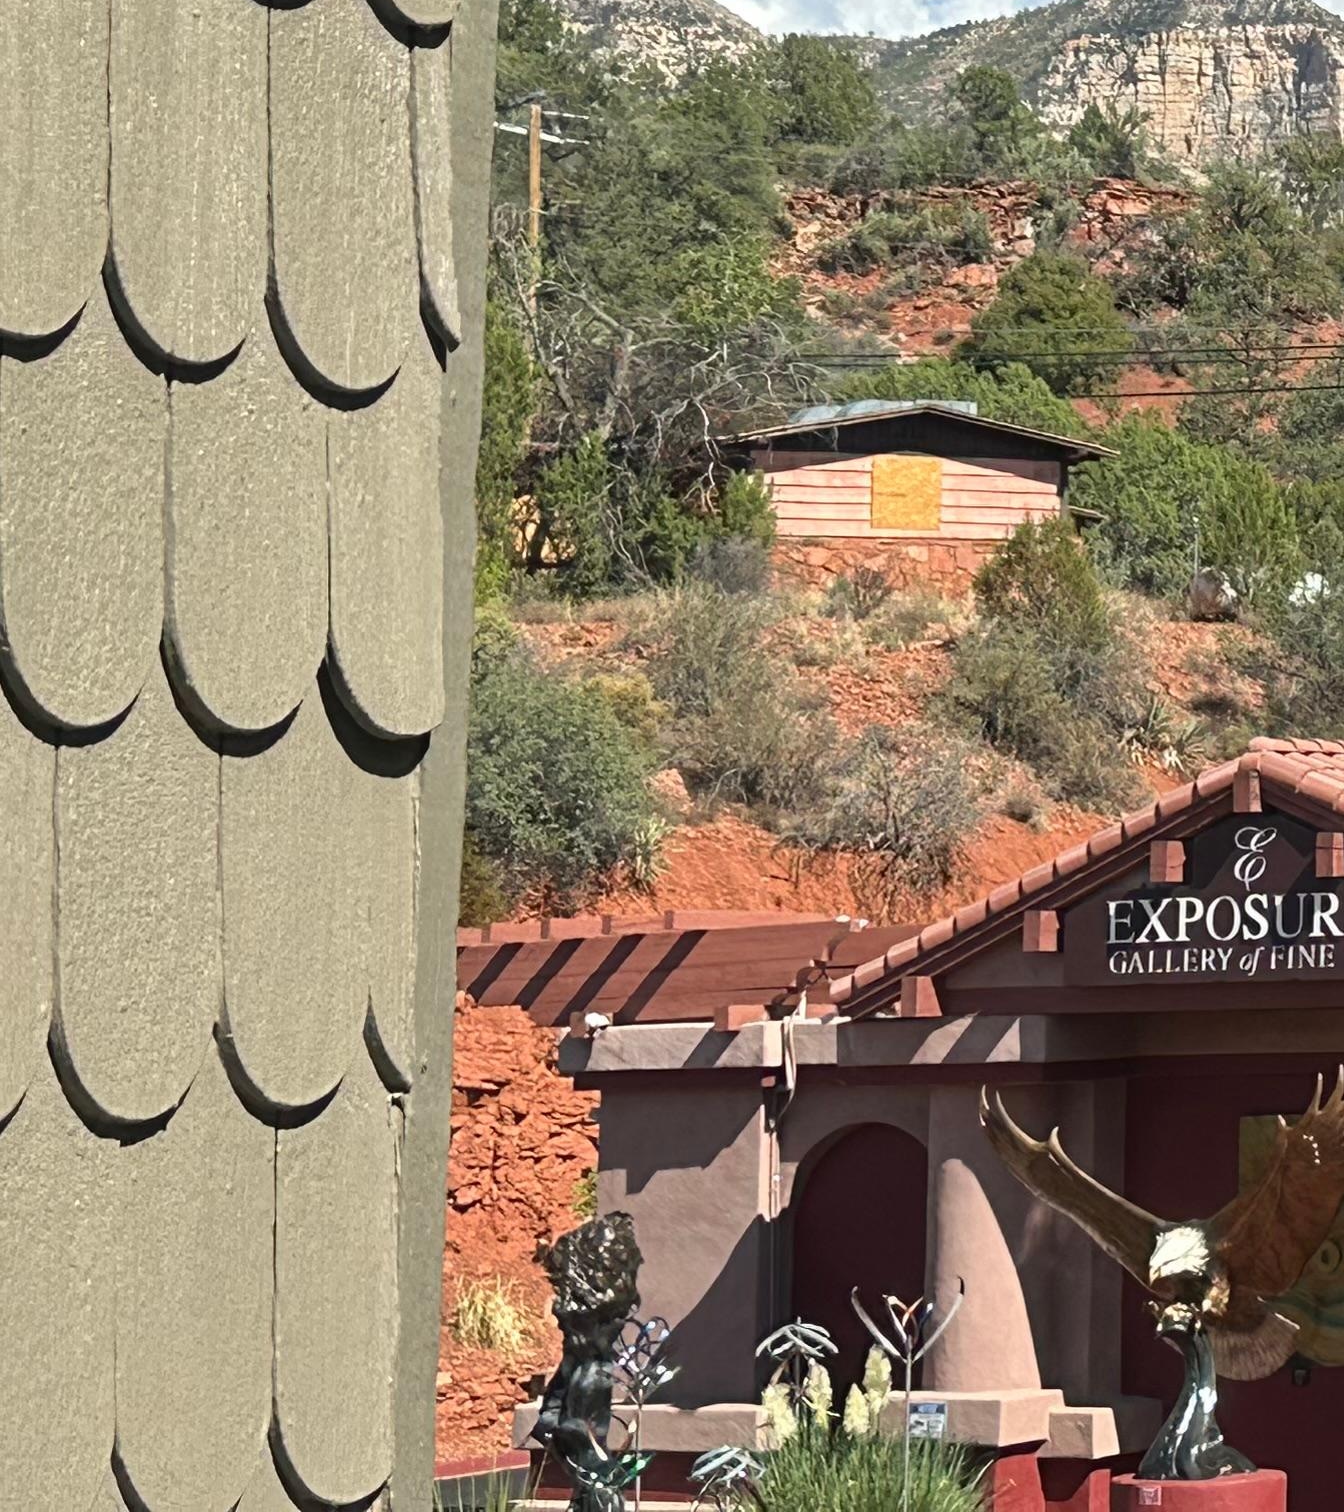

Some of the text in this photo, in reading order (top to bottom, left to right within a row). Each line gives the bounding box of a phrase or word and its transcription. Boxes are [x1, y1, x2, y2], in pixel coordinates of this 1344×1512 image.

[1109, 947, 1234, 974] GALLERY
[1239, 946, 1265, 977] of
[1270, 944, 1335, 969] FINE
